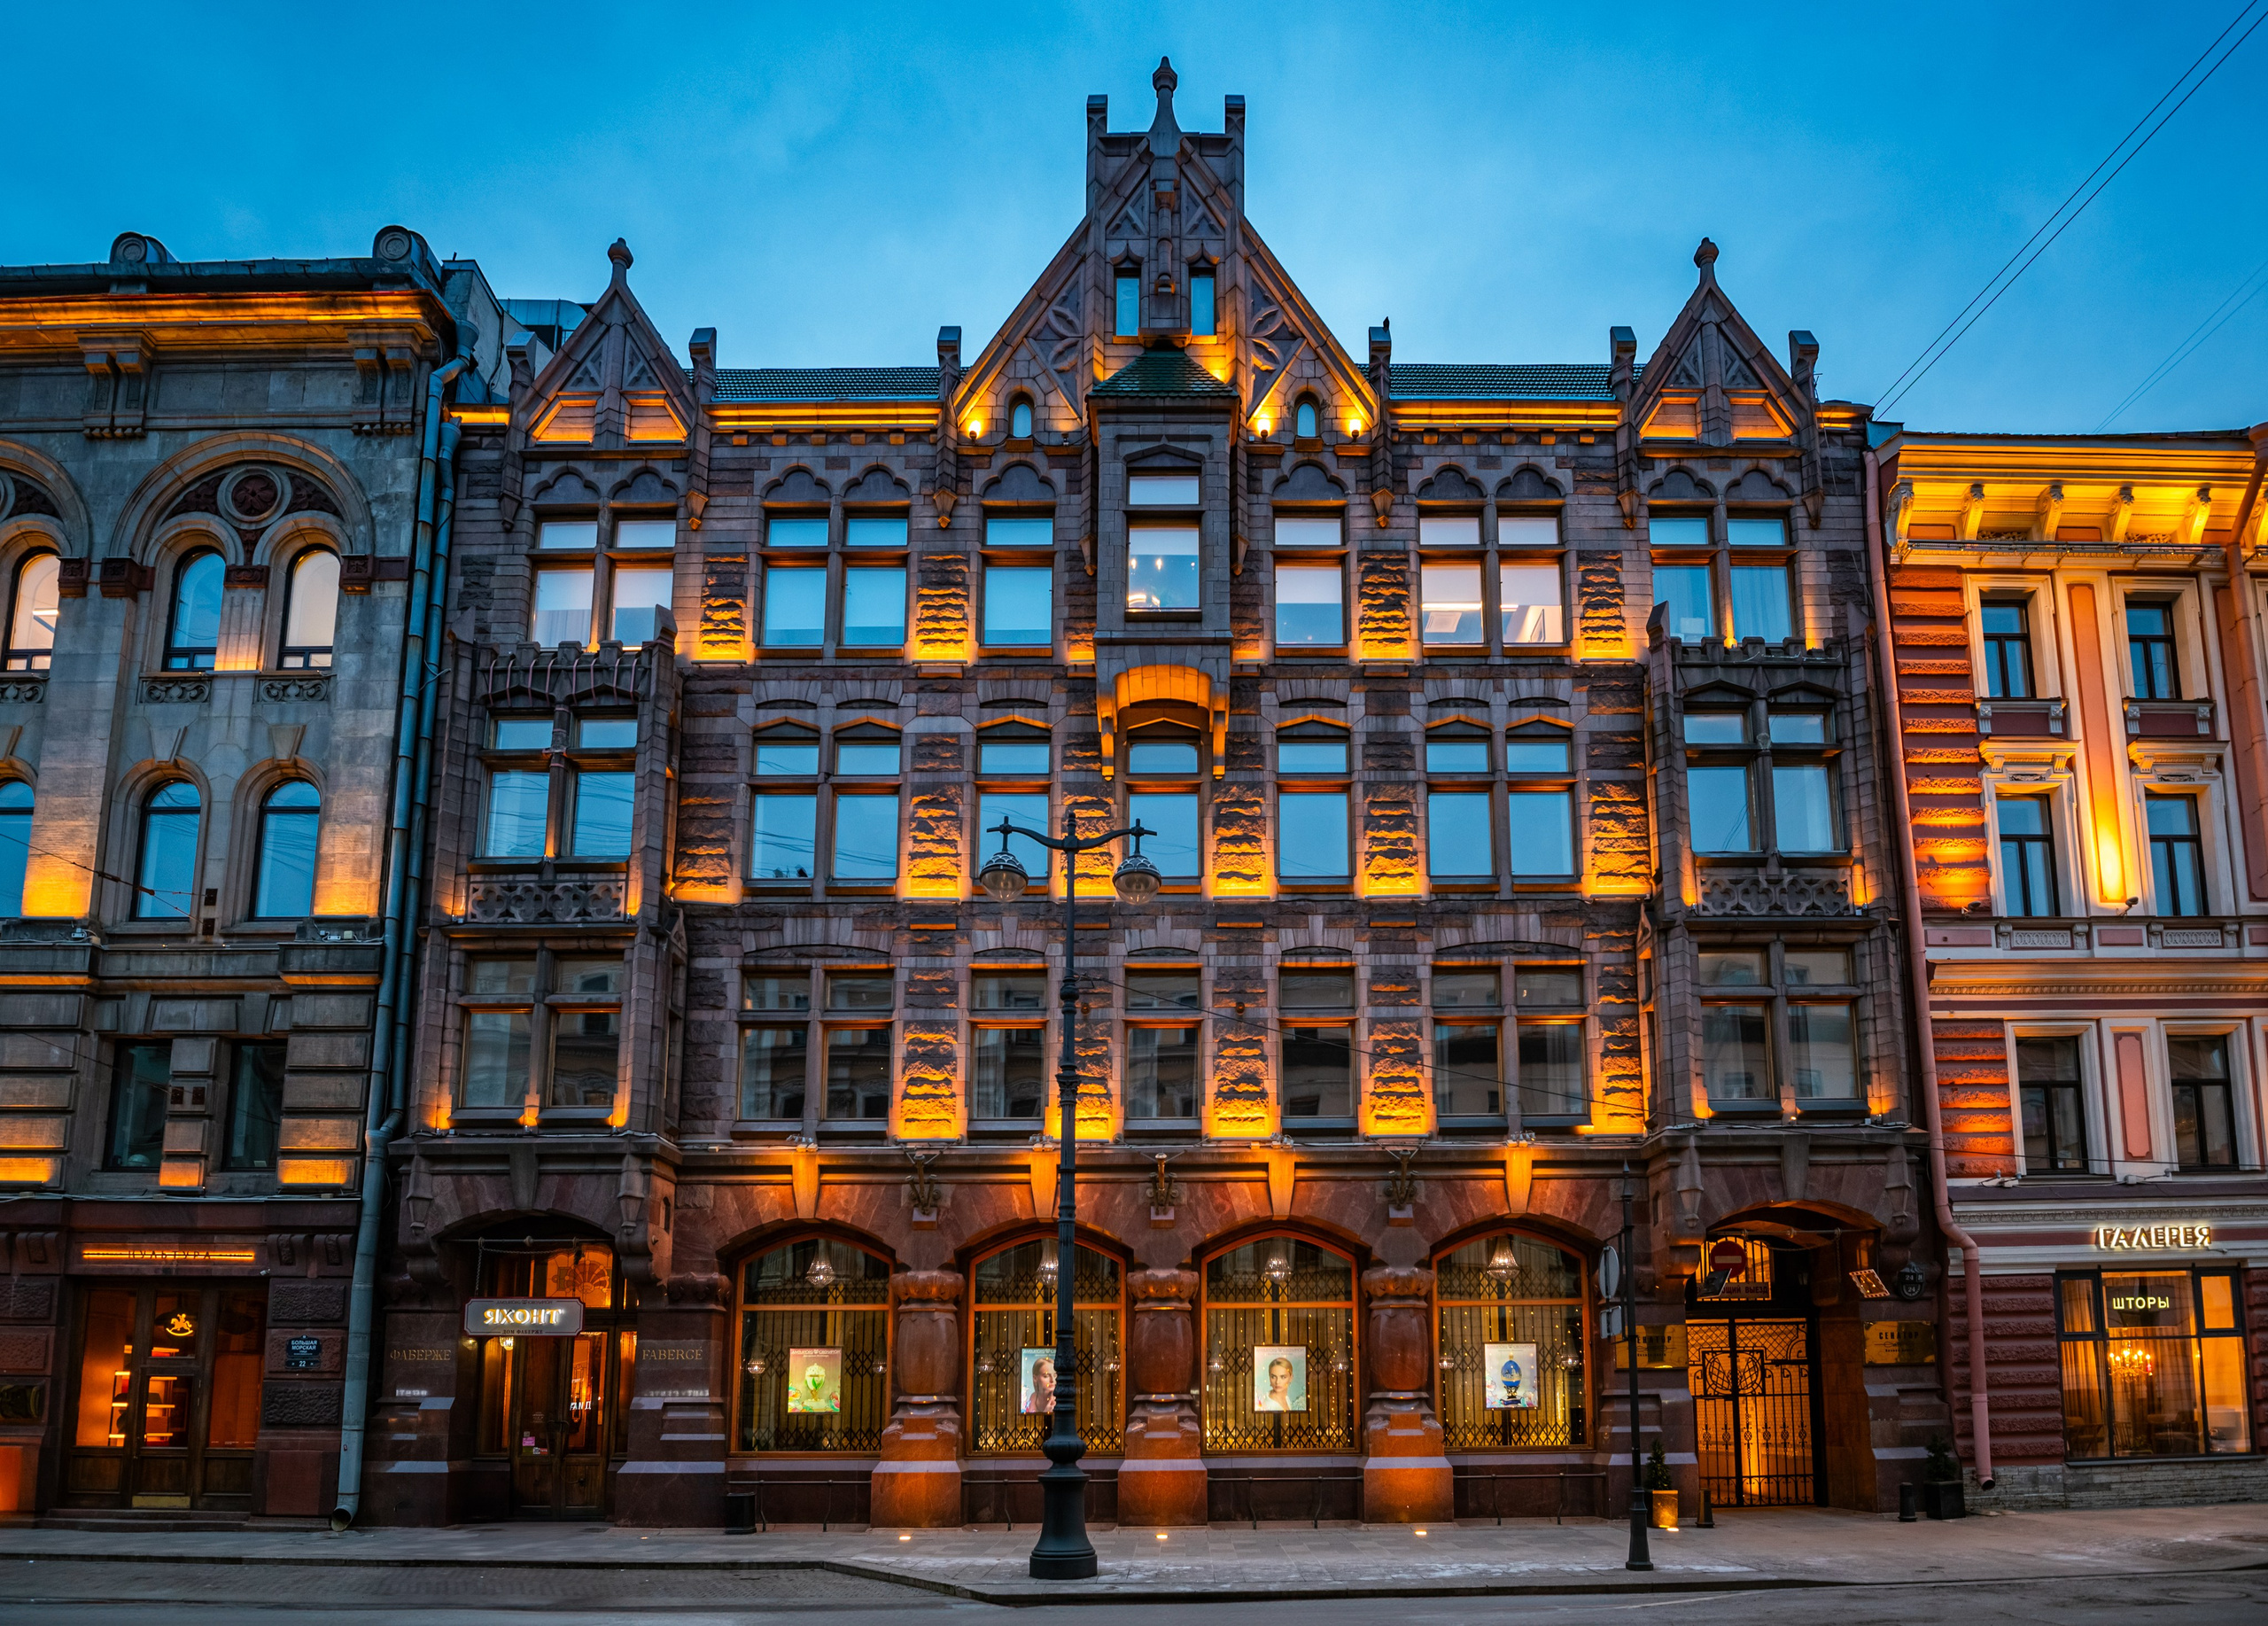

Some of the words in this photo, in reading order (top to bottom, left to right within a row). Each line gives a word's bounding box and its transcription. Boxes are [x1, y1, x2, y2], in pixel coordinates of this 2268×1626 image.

[2095, 1225, 2212, 1249] ГАЛЕРЕЯ
[2112, 1296, 2170, 1310] ШТОРЫ
[483, 1309, 562, 1325] ЯХОНТ
[1636, 1335, 1672, 1344] ЕНАТОР
[1879, 1331, 1919, 1340] СЕНАТОР
[390, 1349, 452, 1361] ФАБЕРЖЕ
[641, 1346, 703, 1360] FABERGÉ
